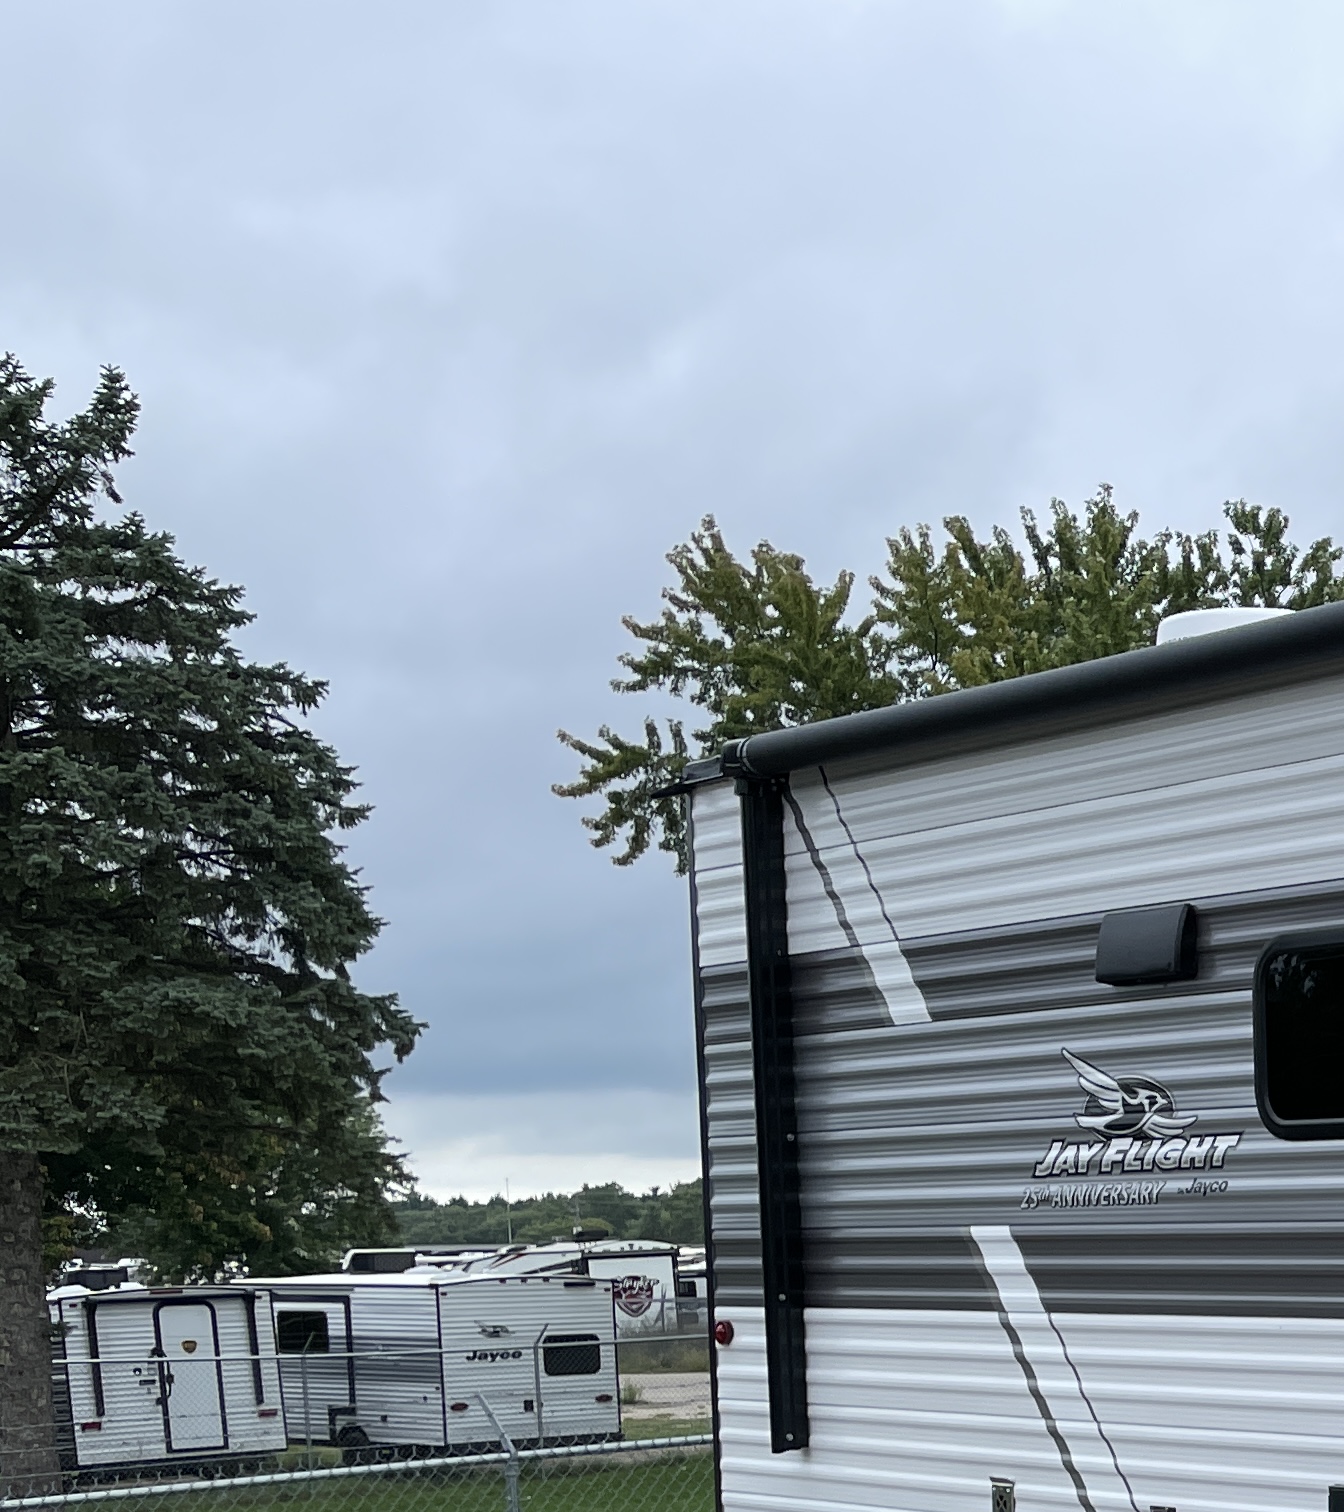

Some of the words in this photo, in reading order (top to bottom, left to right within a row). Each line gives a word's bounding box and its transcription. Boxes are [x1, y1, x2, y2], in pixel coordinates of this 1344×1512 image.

[1032, 1138, 1102, 1178] JAY
[1100, 1131, 1244, 1174] FLIGHT
[1020, 1184, 1050, 1209] 25th
[1051, 1179, 1167, 1209] ANNIVERSARY
[1185, 1177, 1229, 1197] Jayco
[466, 1350, 522, 1362] Jayco
